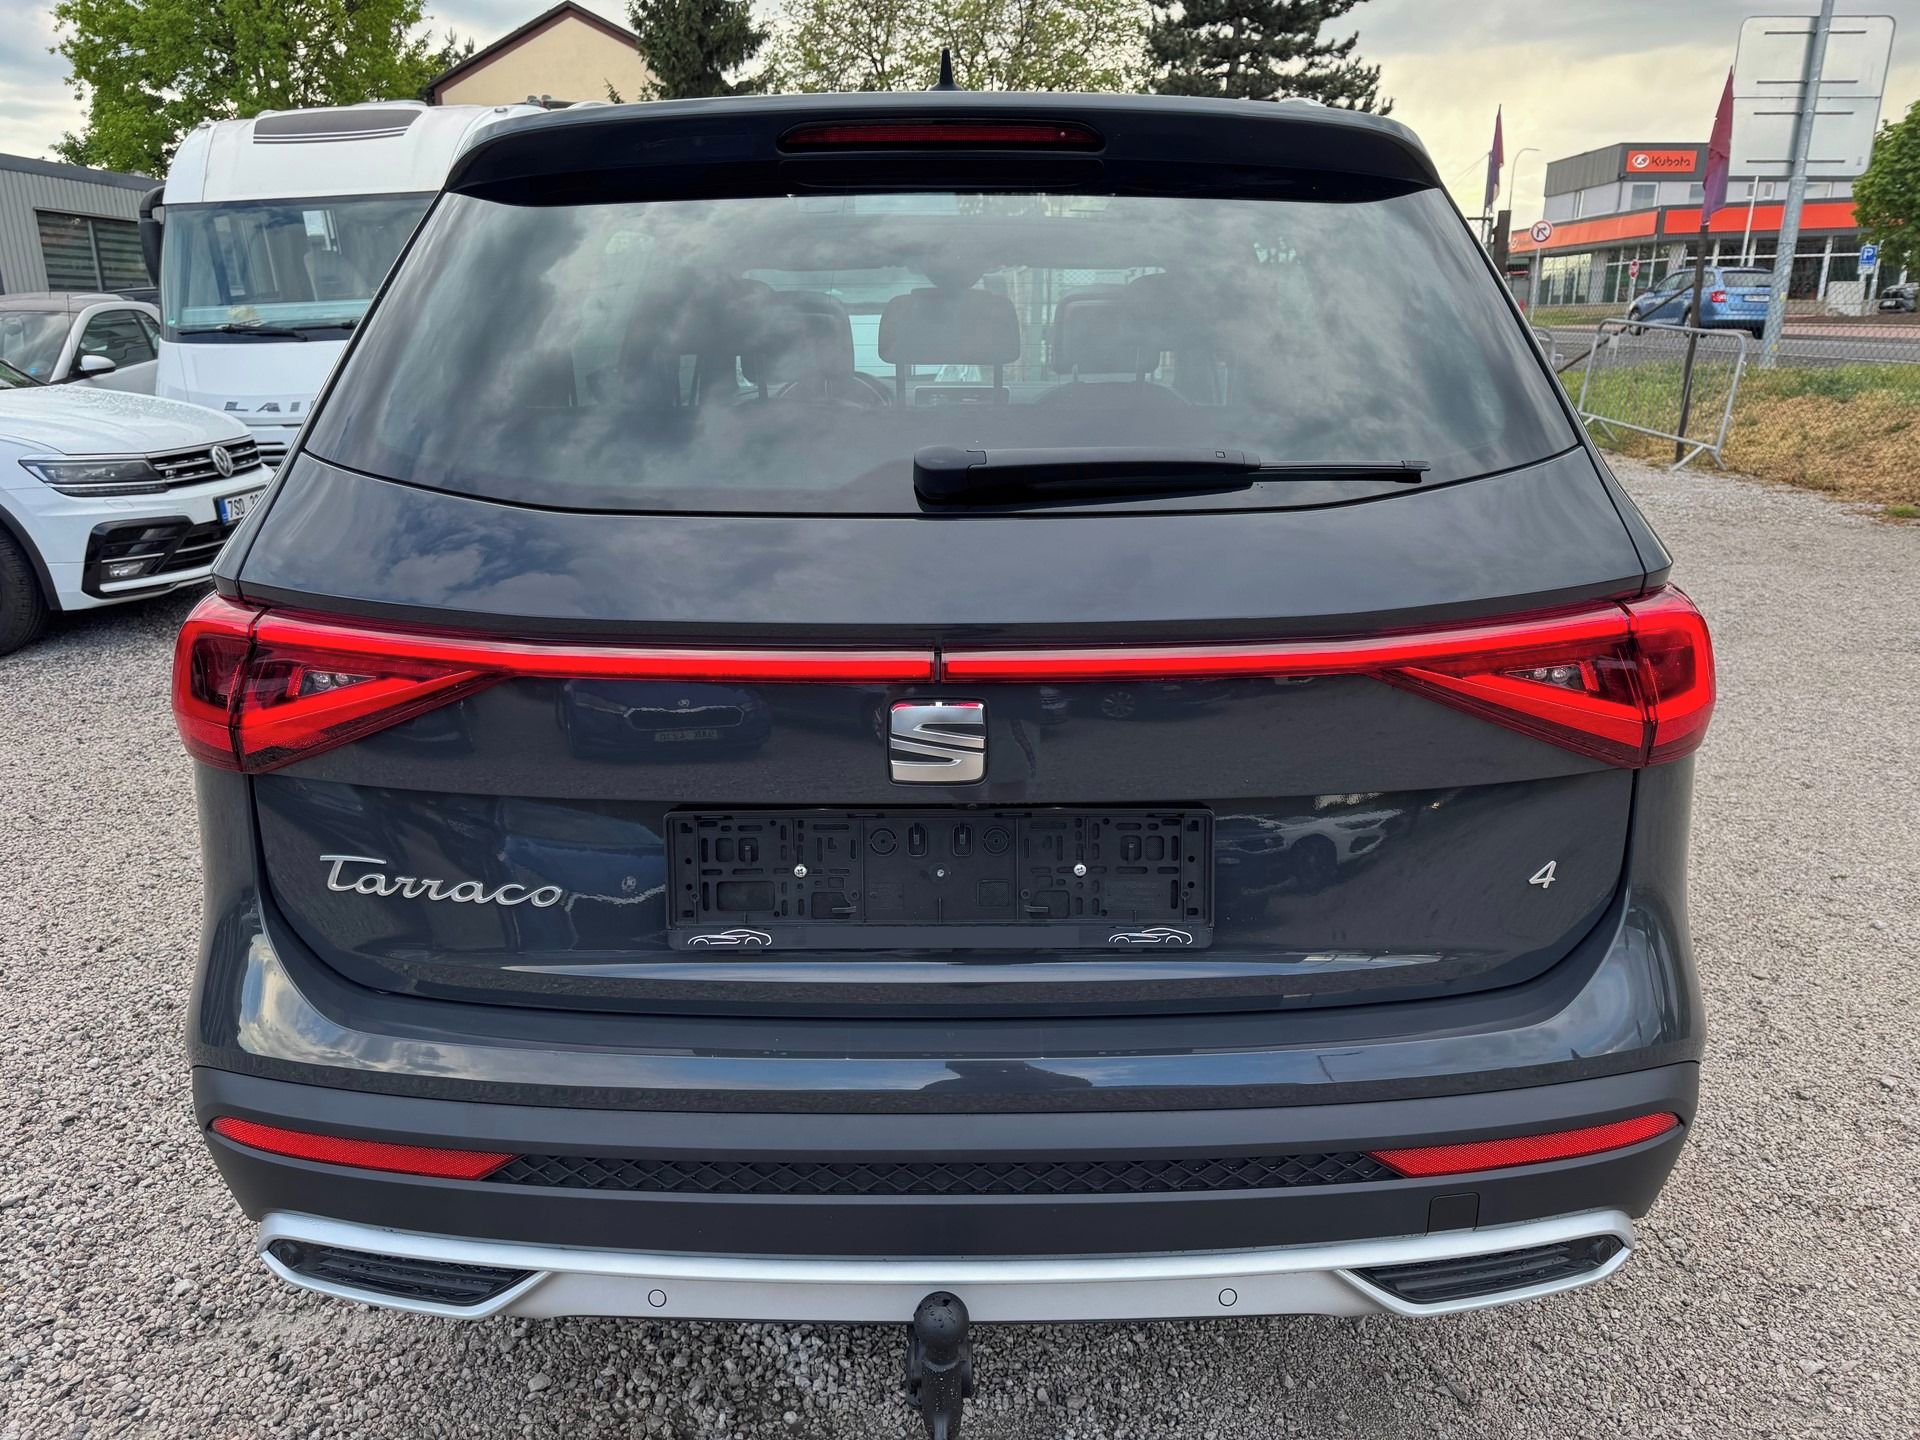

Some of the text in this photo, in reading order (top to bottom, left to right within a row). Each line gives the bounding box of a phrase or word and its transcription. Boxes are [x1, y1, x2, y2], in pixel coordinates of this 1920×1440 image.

[1651, 155, 1691, 167] Kubota
[1863, 248, 1874, 261] P
[224, 401, 315, 413] LAI
[319, 854, 563, 907] Tarraco
[1528, 860, 1557, 889] 4
